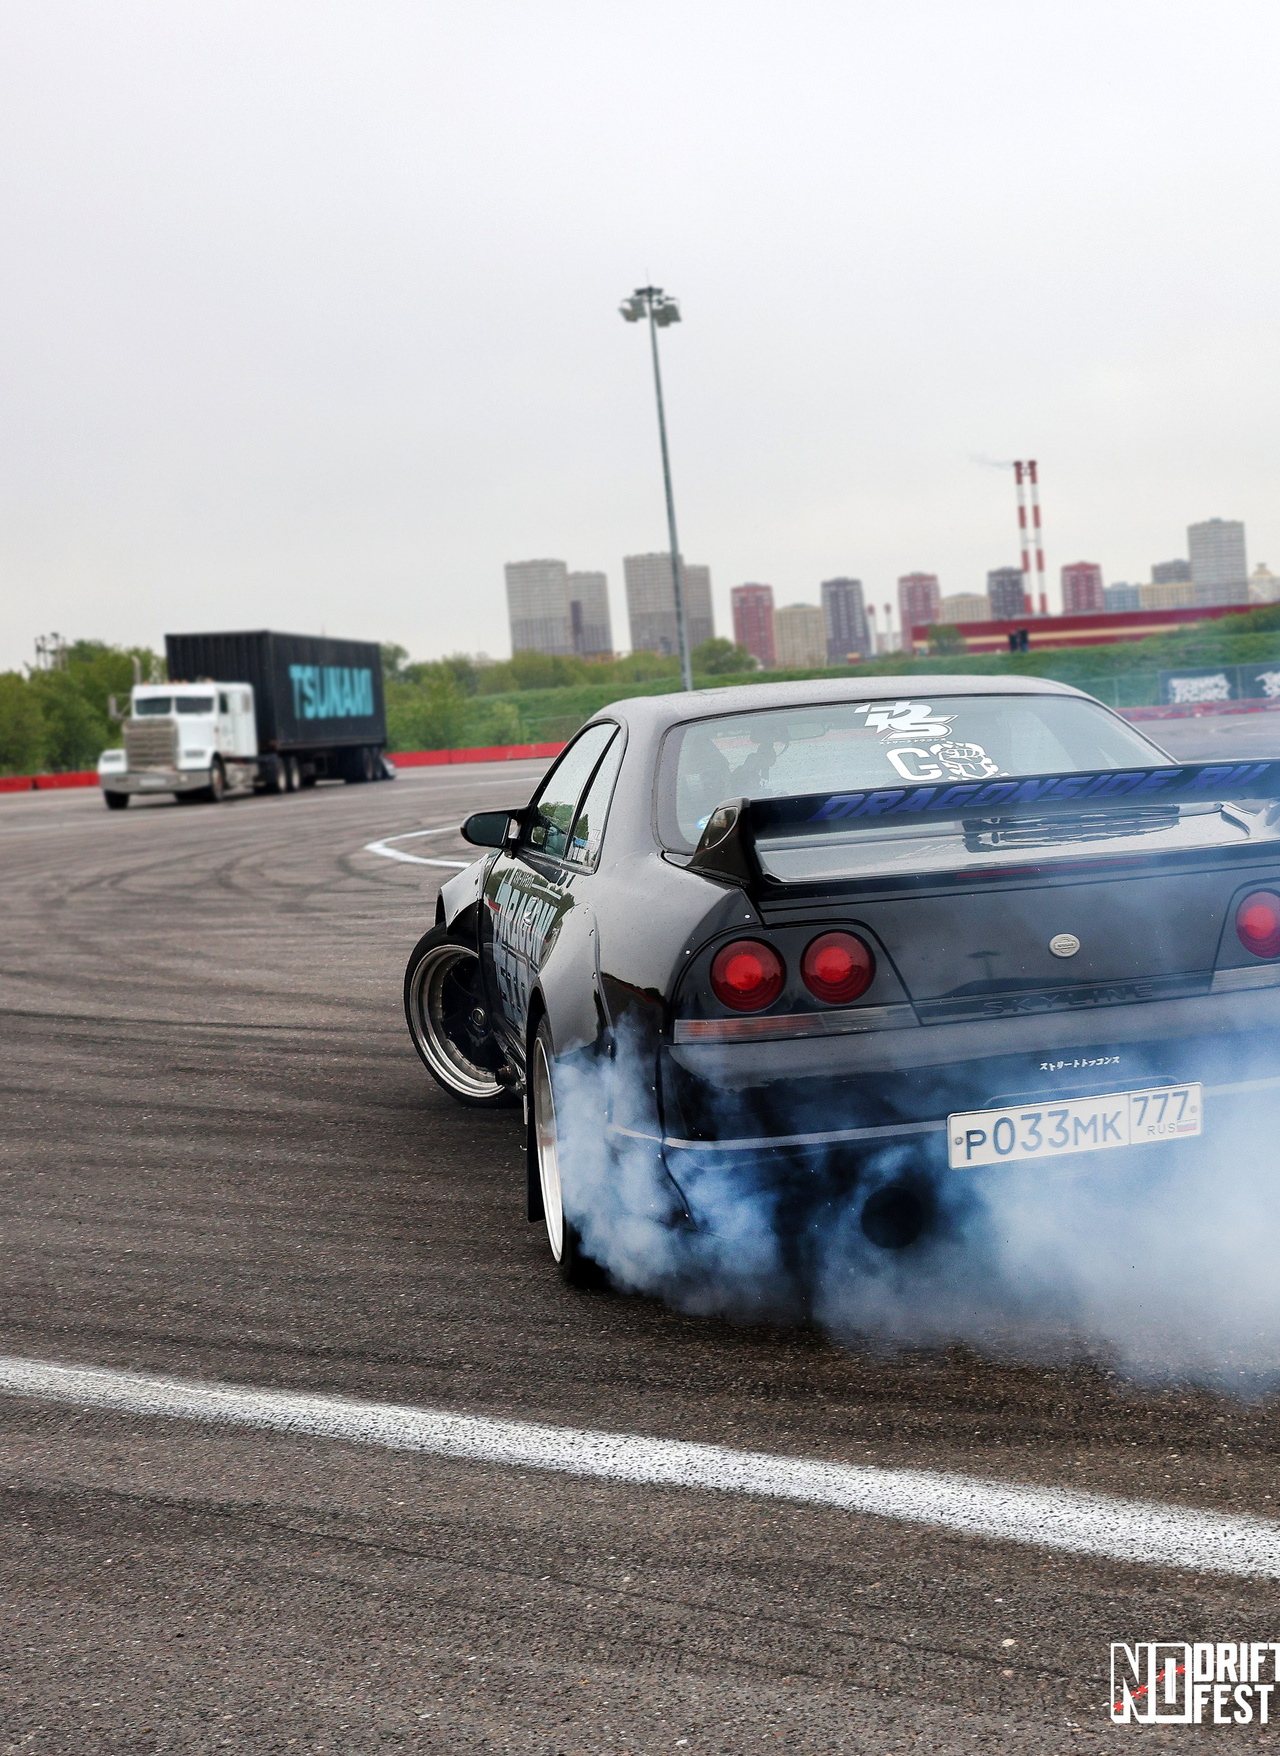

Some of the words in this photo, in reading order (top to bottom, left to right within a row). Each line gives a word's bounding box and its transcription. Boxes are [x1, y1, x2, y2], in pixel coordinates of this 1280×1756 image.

[807, 763, 1271, 822] DRAGONSIDE.RU
[983, 983, 1154, 1015] SKYLINE
[1132, 1090, 1190, 1127] 777
[1147, 1122, 1176, 1136] RUS
